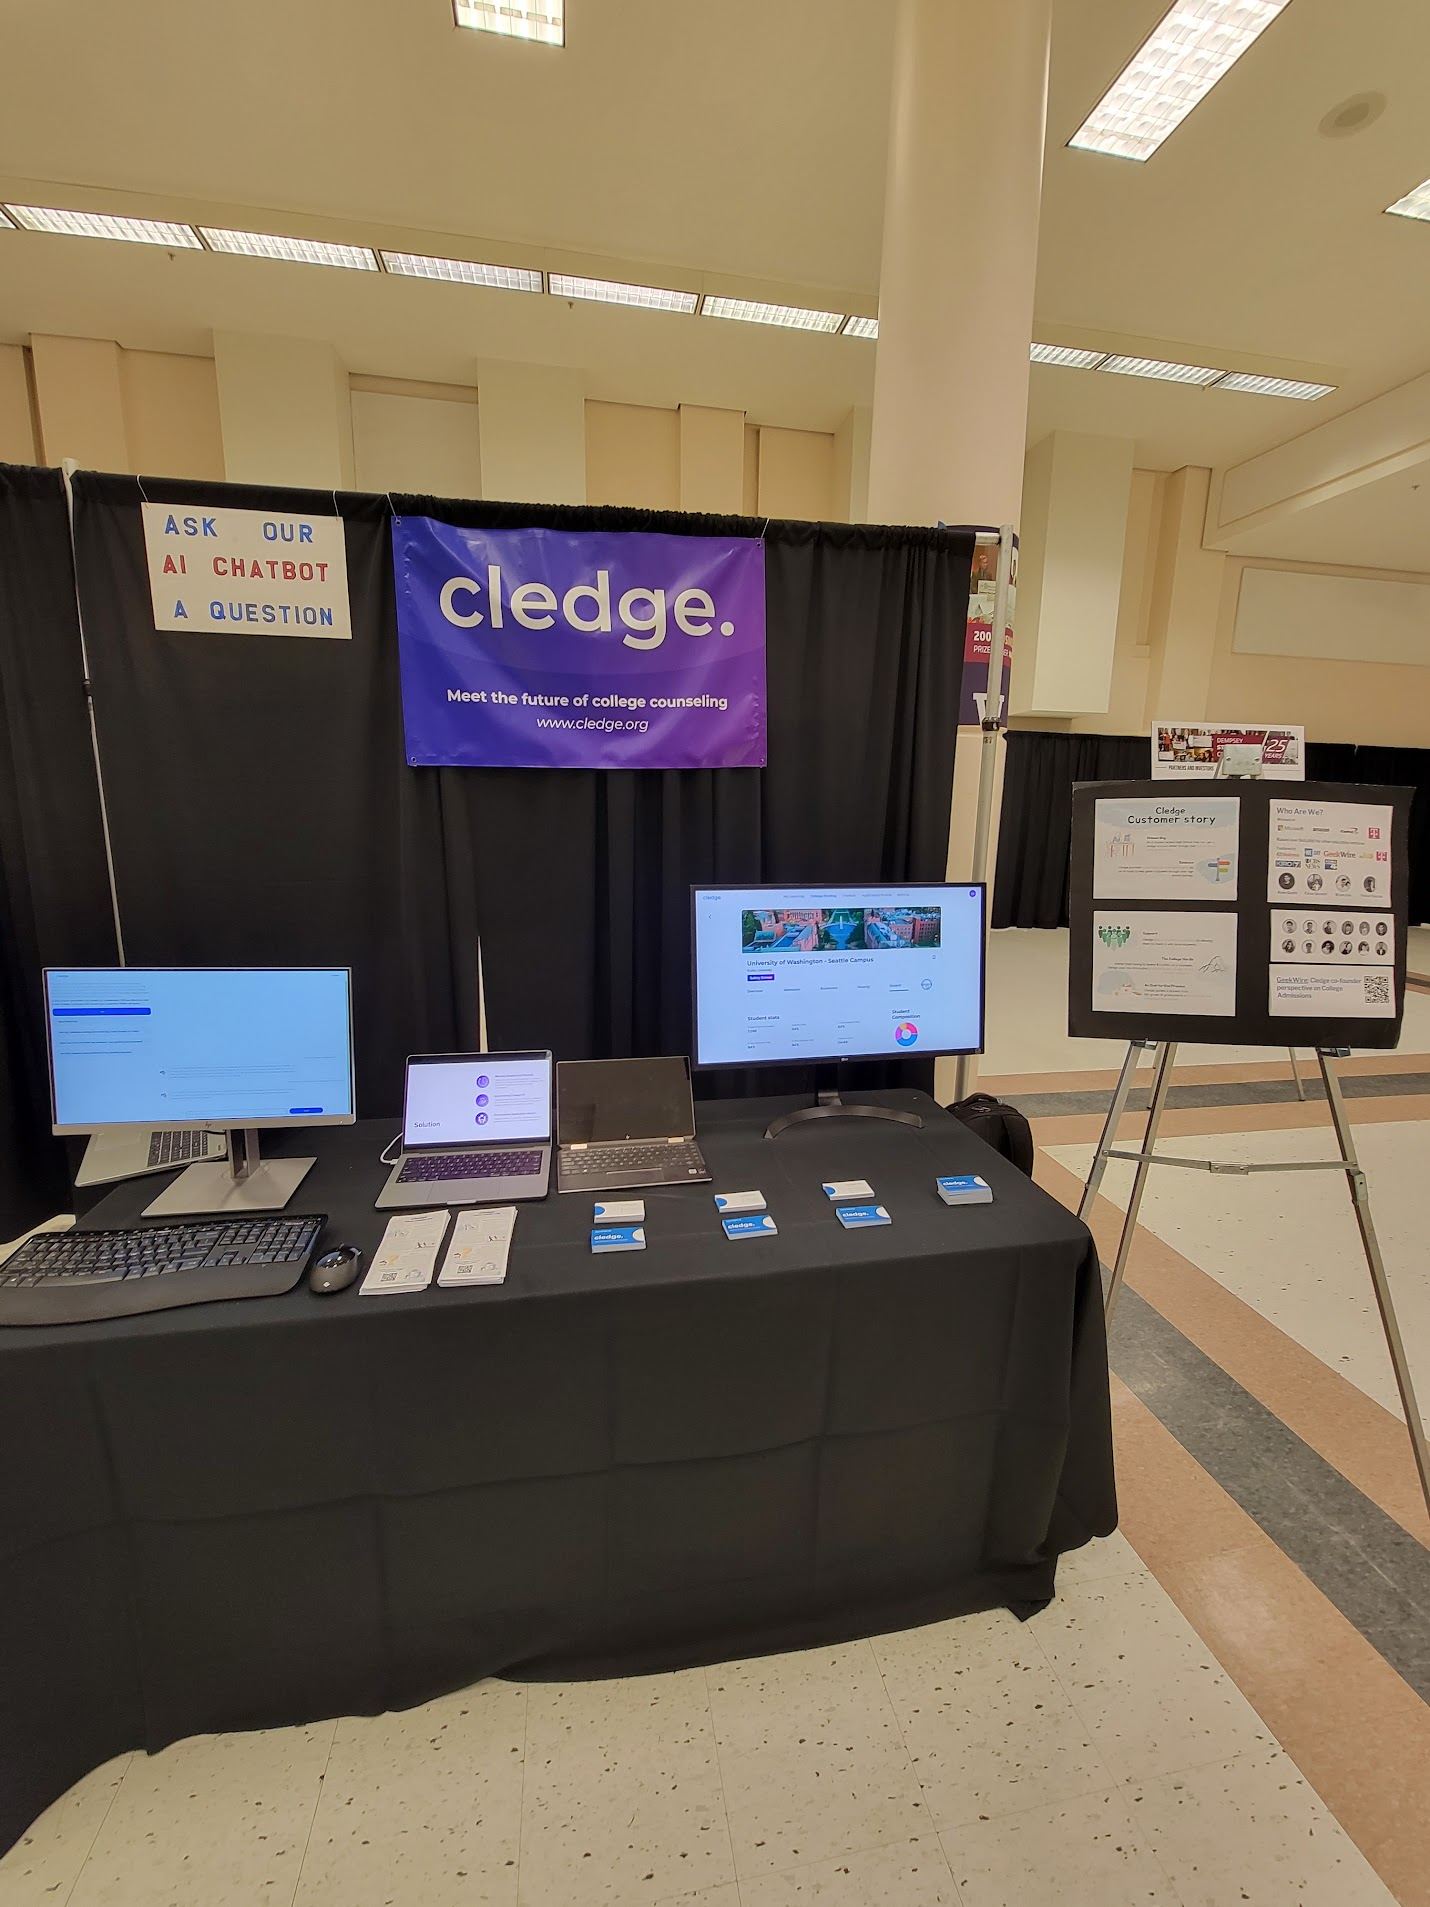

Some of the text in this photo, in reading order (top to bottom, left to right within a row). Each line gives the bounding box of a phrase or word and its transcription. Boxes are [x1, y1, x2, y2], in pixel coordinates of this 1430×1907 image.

[164, 514, 314, 543] ASK OUR
[163, 554, 329, 582] AI CHATBOT
[174, 600, 333, 626] A QUESTION
[439, 564, 735, 651] cledge.
[447, 689, 728, 711] Meet the future of college counseling
[537, 717, 649, 733] www.cledge.org
[1266, 739, 1288, 752] 25
[1155, 806, 1186, 816] Cledge
[1276, 807, 1293, 815] Who
[1127, 815, 1216, 825] Customer story
[1323, 850, 1356, 859] GeekWire
[747, 959, 777, 967] University
[787, 958, 823, 966] Washington
